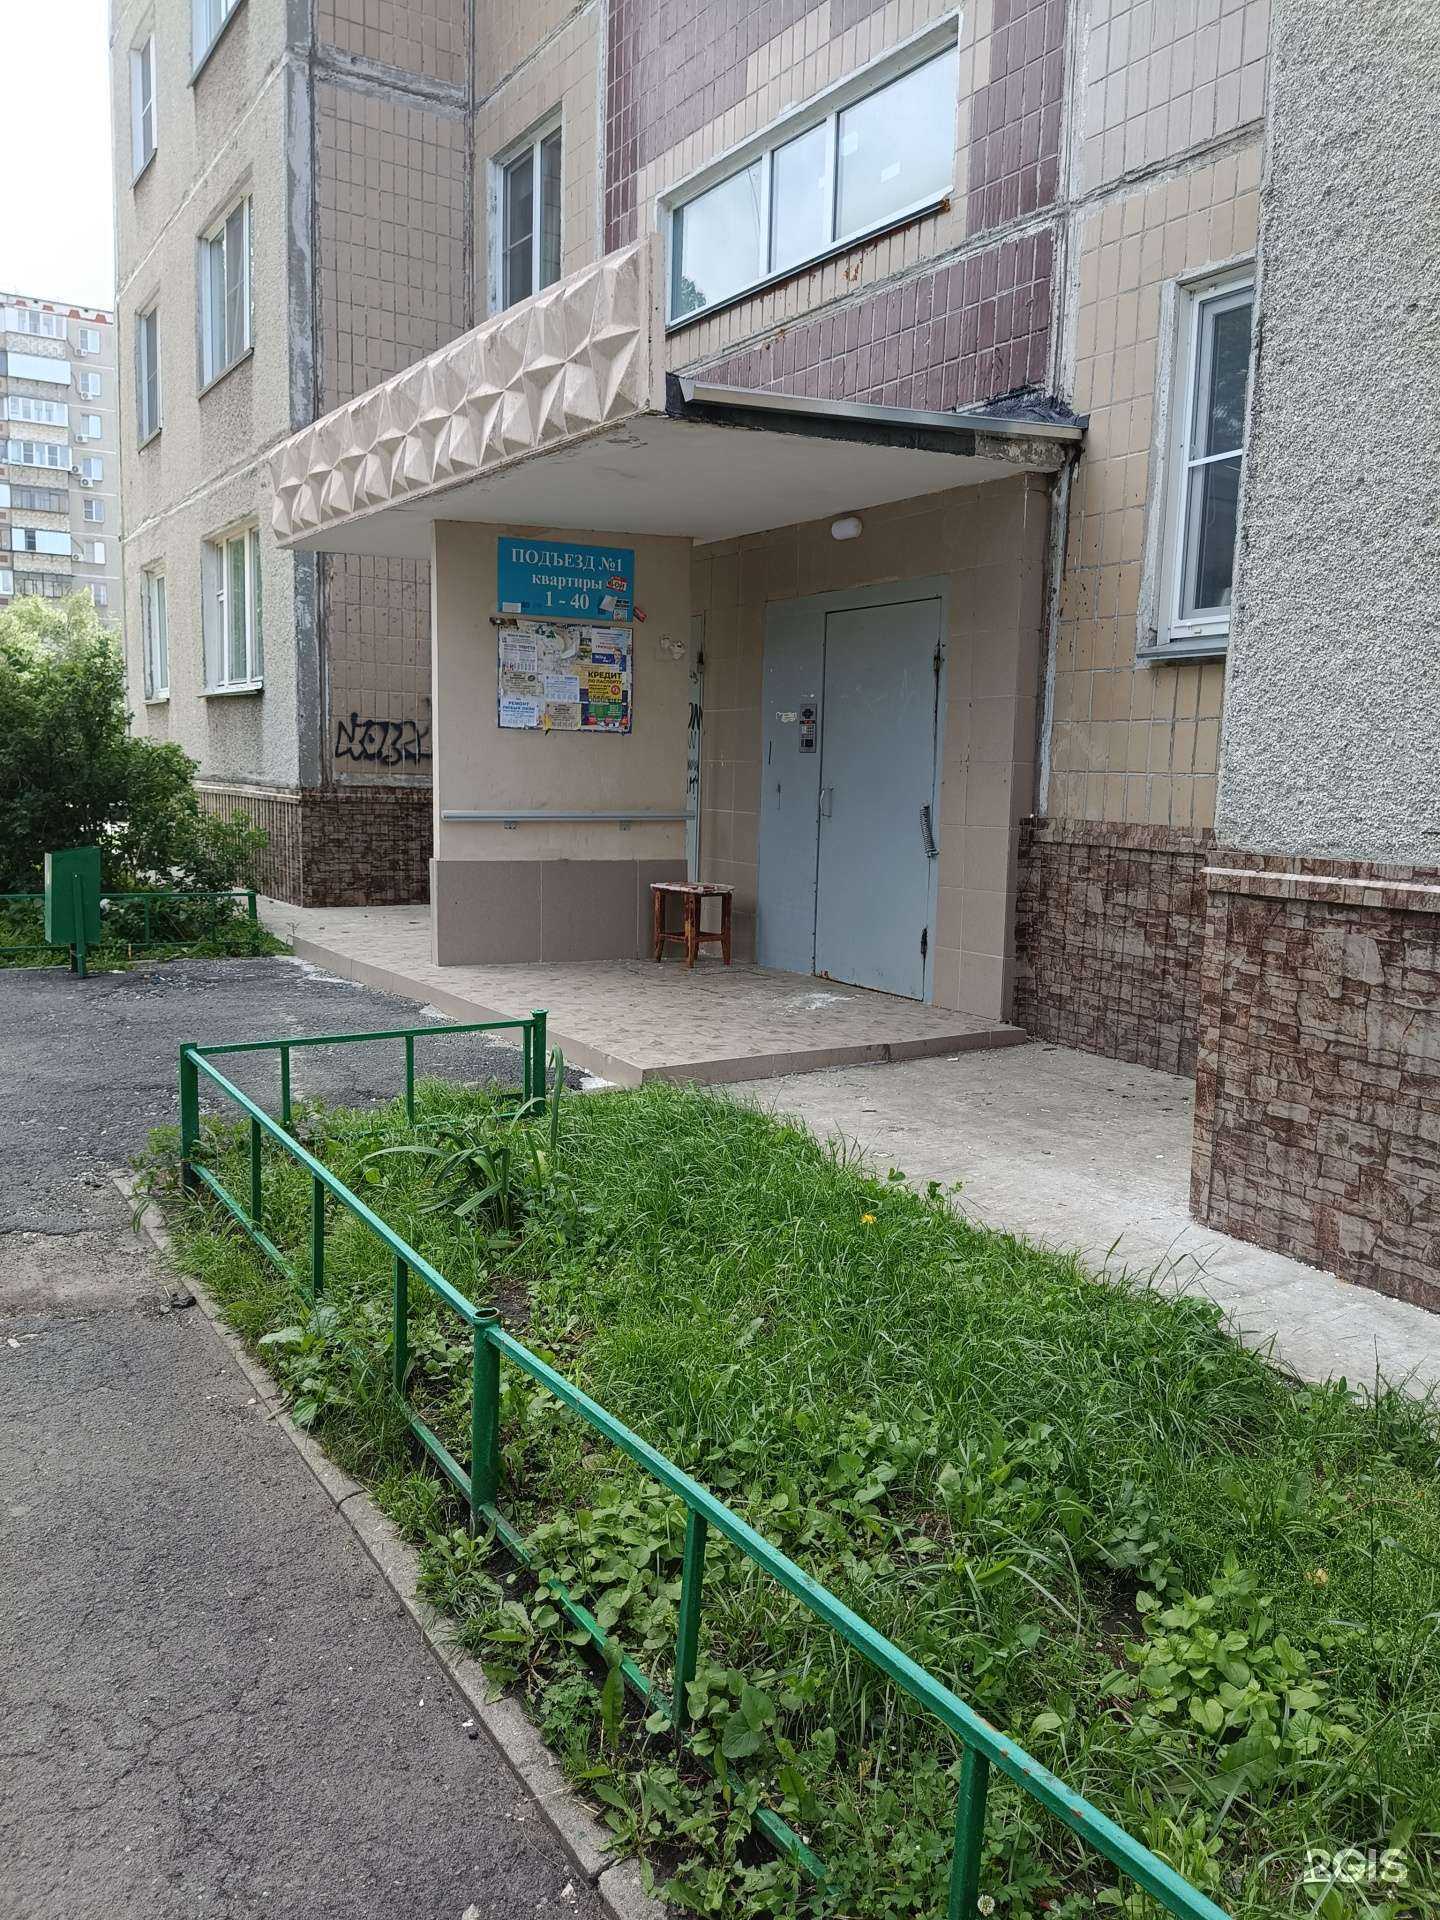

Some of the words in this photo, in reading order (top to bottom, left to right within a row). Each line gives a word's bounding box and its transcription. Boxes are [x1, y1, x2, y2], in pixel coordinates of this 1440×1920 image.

[512, 548, 595, 572] ПОДЪЕЗД
[599, 558, 622, 572] №1
[532, 574, 602, 591] квартиры
[570, 593, 590, 609] 40
[588, 671, 622, 680] КРЕДИТ
